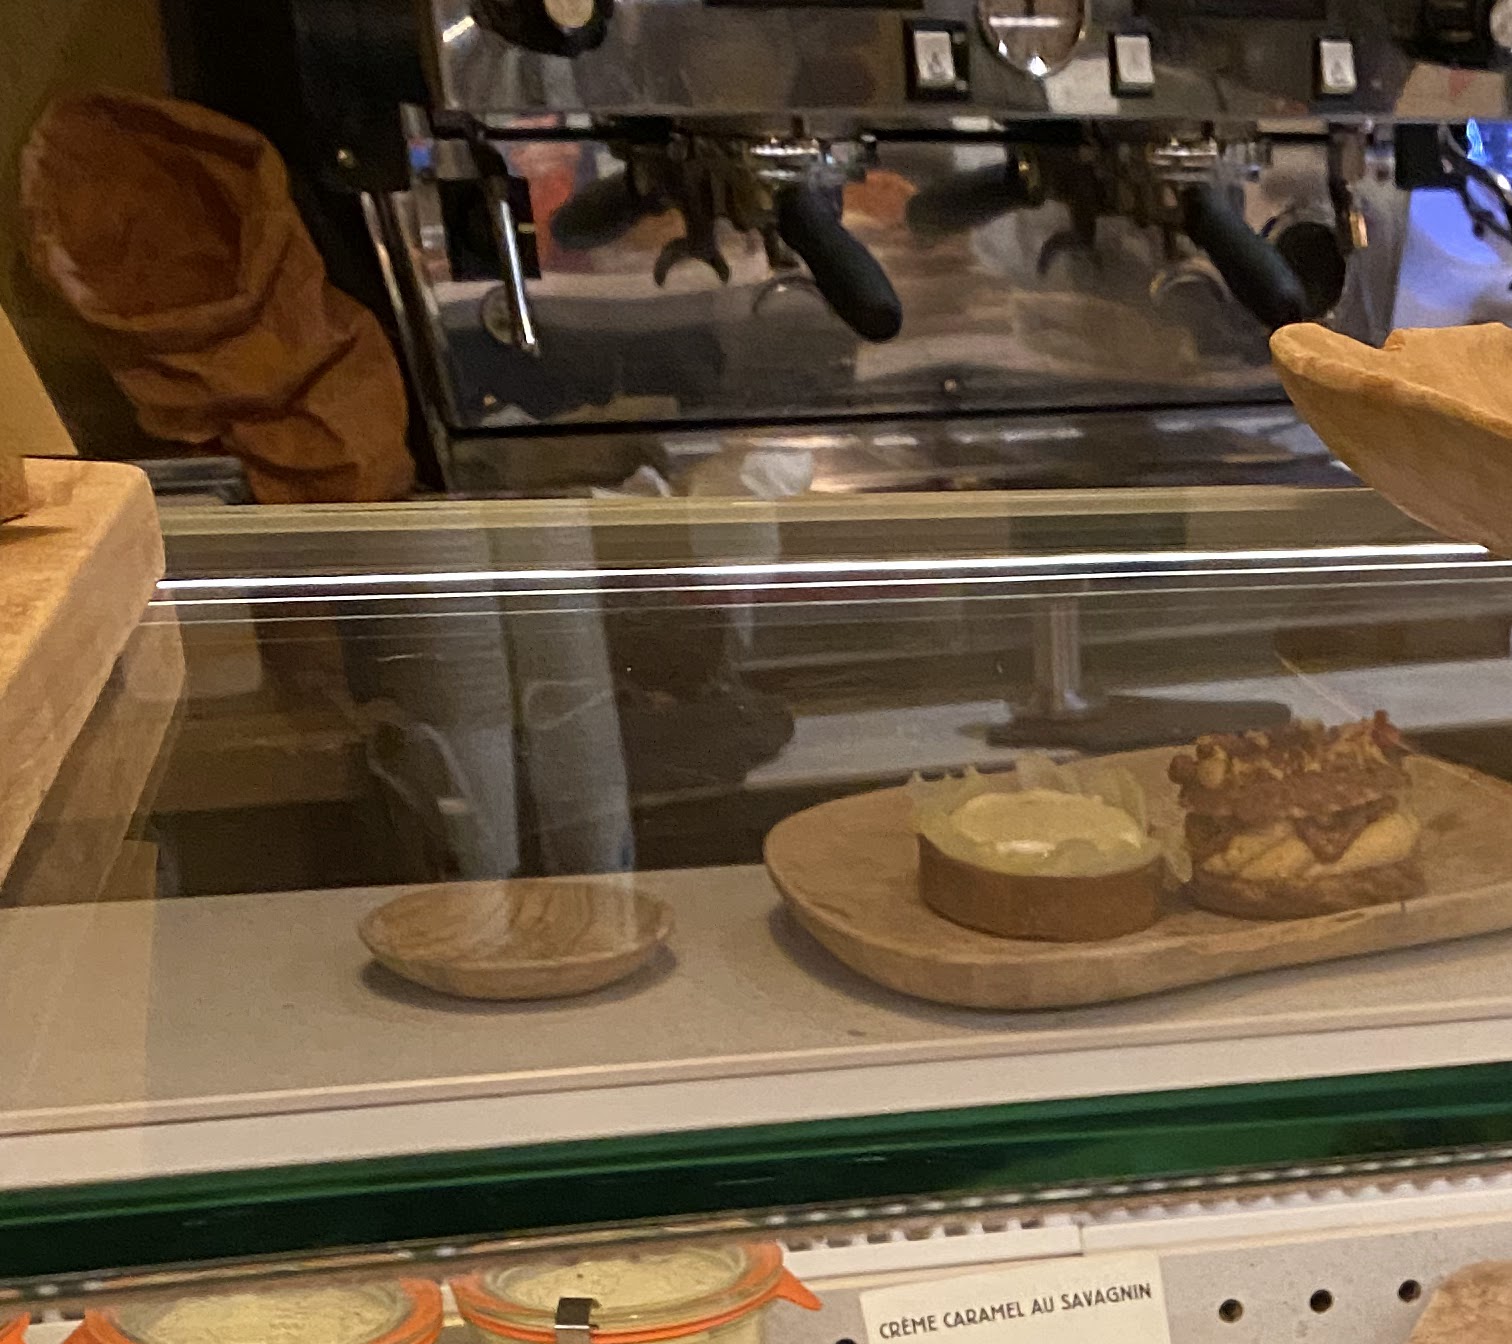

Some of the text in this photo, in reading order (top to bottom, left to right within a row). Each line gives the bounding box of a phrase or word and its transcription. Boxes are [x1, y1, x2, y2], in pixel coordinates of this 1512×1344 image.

[943, 1302, 1024, 1328] CARAMEL
[1031, 1296, 1054, 1315] AU
[1061, 1283, 1151, 1310] SAVAGNIN
